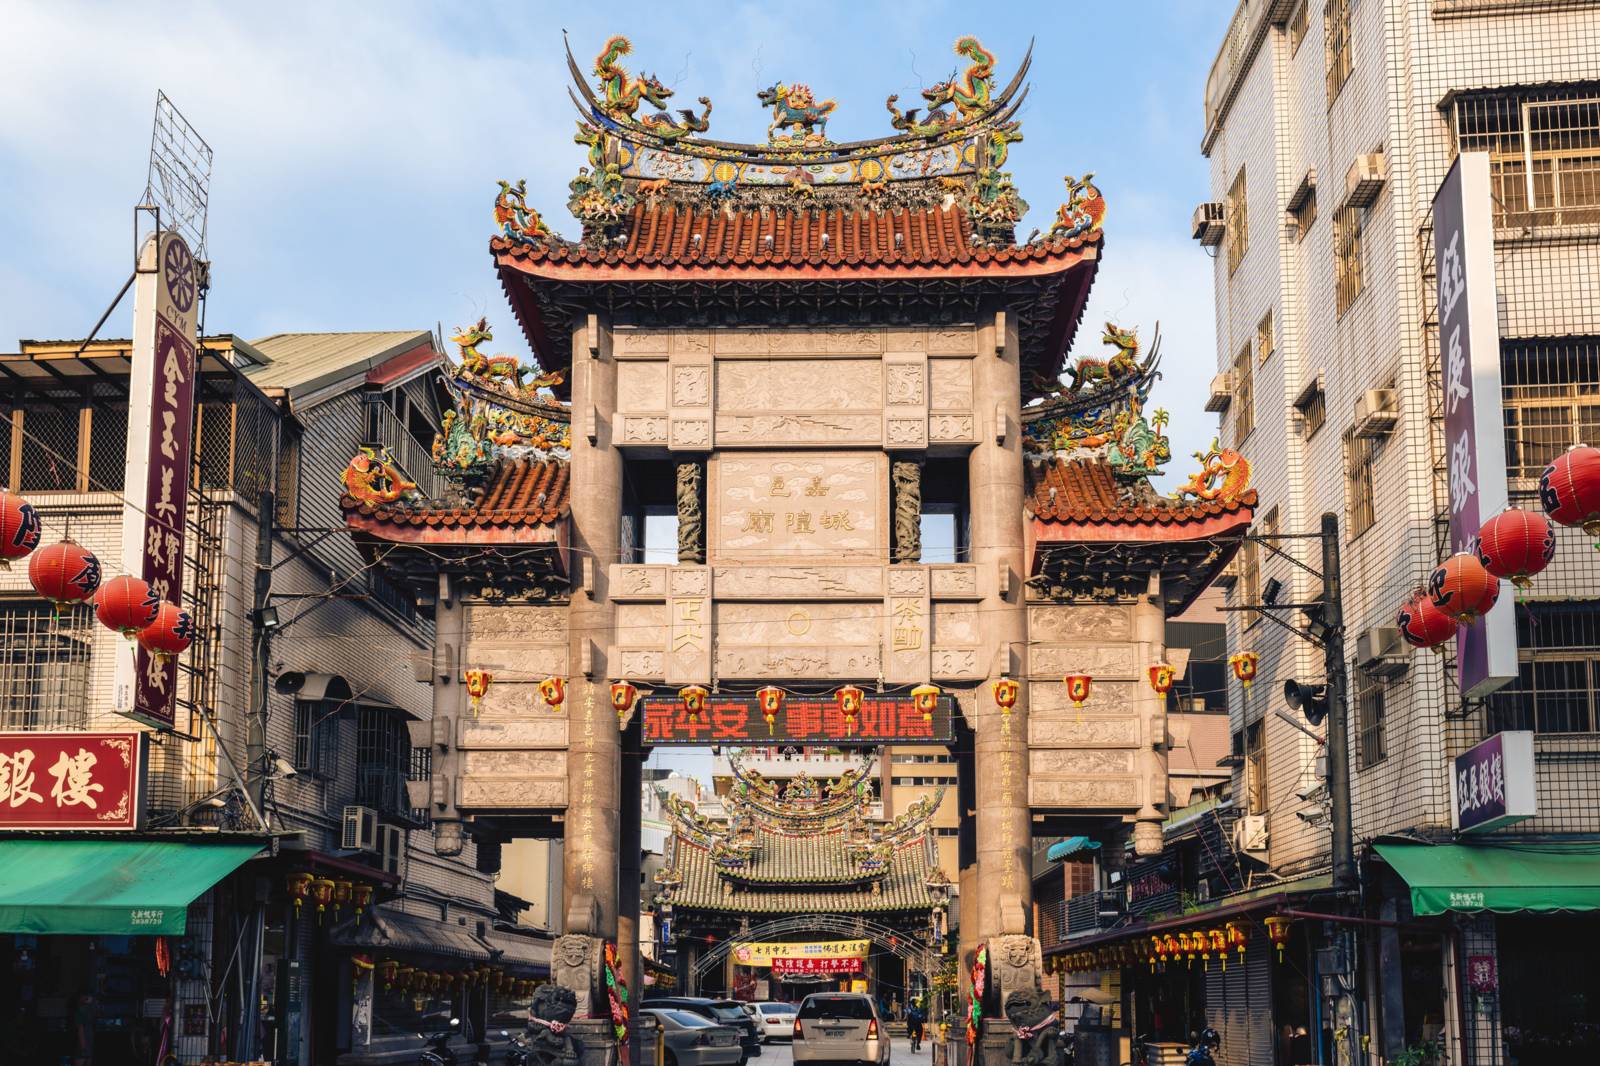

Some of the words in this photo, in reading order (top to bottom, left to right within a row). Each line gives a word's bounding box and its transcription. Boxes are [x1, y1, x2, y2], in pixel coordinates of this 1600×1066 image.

[166, 304, 188, 333] CYM
[1440, 229, 1477, 556] 鈺展銀
